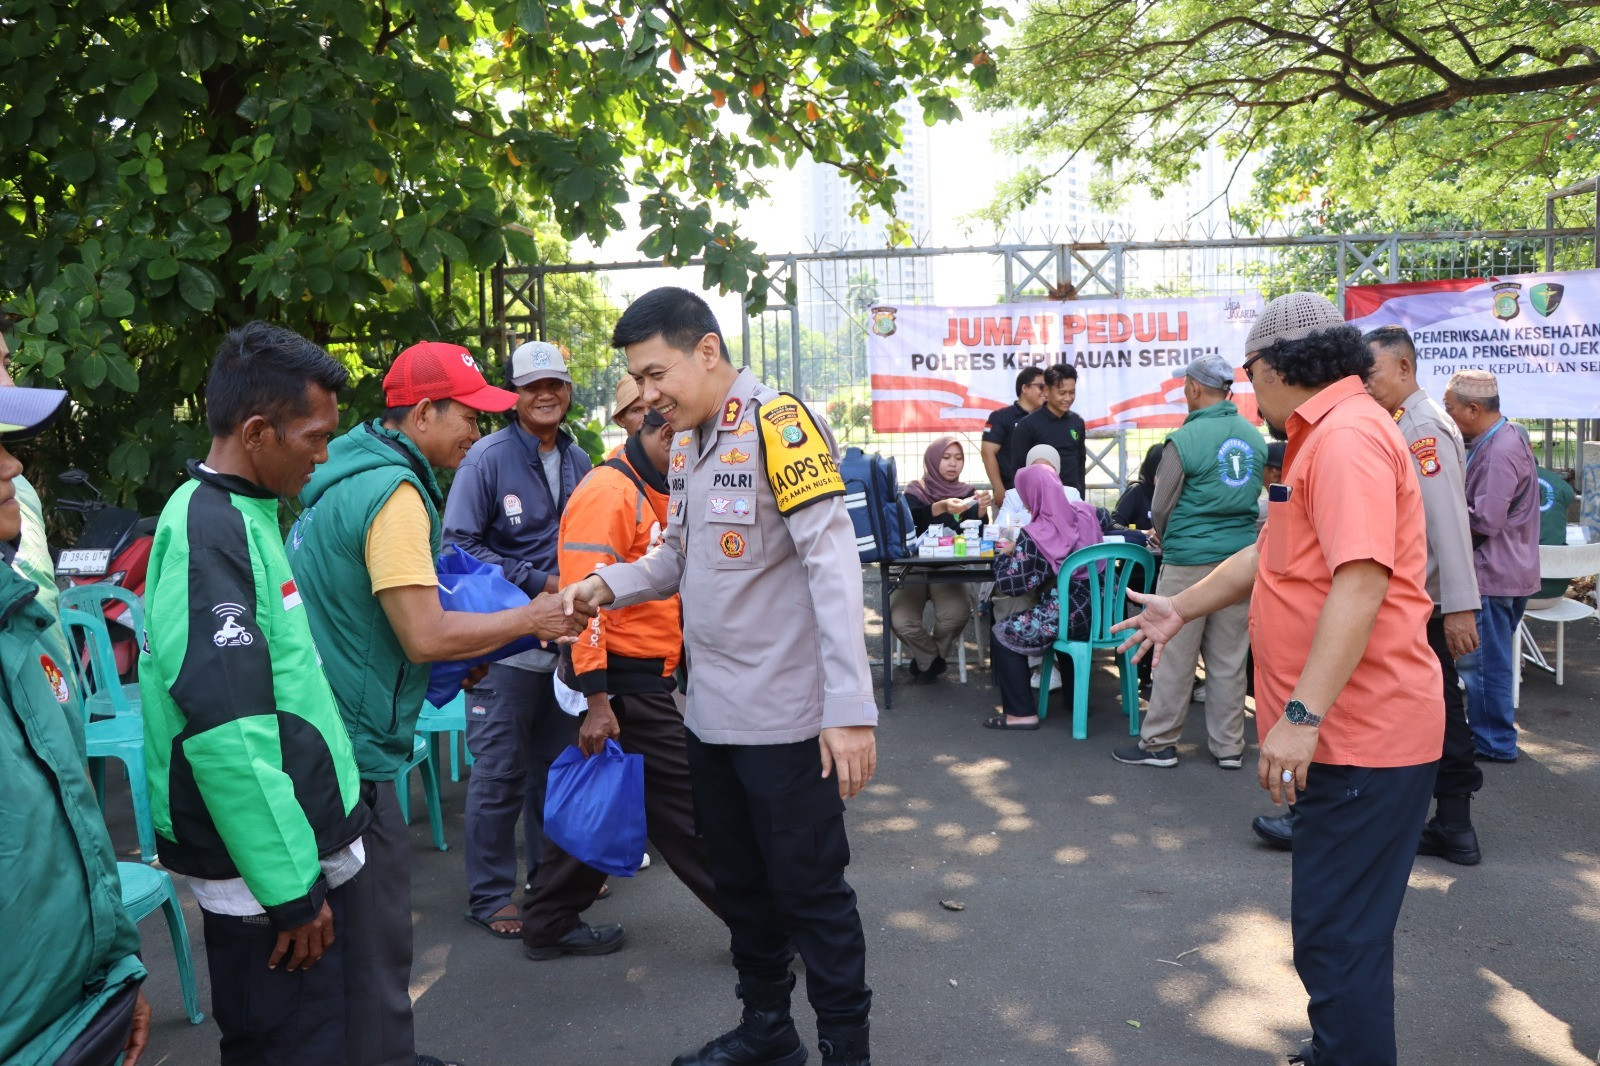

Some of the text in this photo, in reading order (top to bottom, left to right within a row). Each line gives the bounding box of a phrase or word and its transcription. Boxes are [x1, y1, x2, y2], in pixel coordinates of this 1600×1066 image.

[943, 311, 1188, 346] JUMAT PEDULI
[1413, 323, 1600, 344] PEMERIKSAAN KESEHATAN
[911, 353, 996, 371] POLRES
[1003, 350, 1131, 370] KEPULAUAN
[1416, 341, 1599, 360] KEPADA PENGEMUDI OJEK
[1489, 362, 1576, 374] KEPULAUAN
[713, 473, 752, 488] POLRI
[790, 484, 811, 499] AMAN
[813, 477, 832, 488] NUSA
[510, 516, 521, 525] TN
